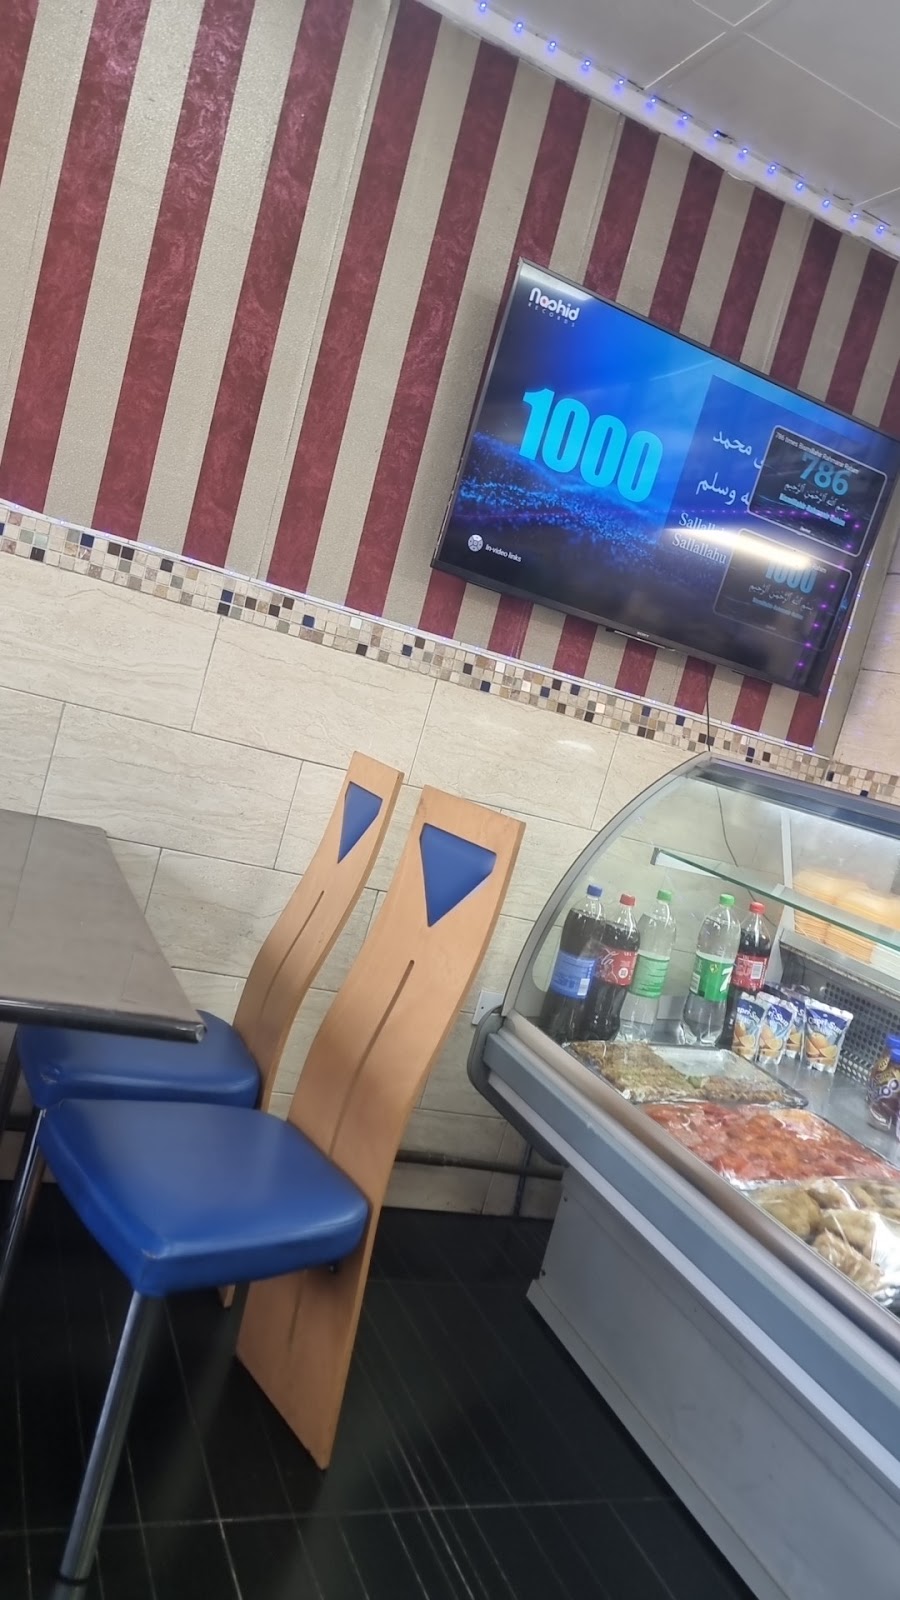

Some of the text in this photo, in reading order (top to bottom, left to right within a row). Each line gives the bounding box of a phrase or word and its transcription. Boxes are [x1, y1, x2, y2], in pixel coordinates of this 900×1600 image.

[519, 388, 663, 502] 1000
[713, 431, 752, 455] محمد
[696, 472, 736, 505] وسلم
[800, 452, 852, 495] 786
[672, 532, 727, 564] Sallallahu
